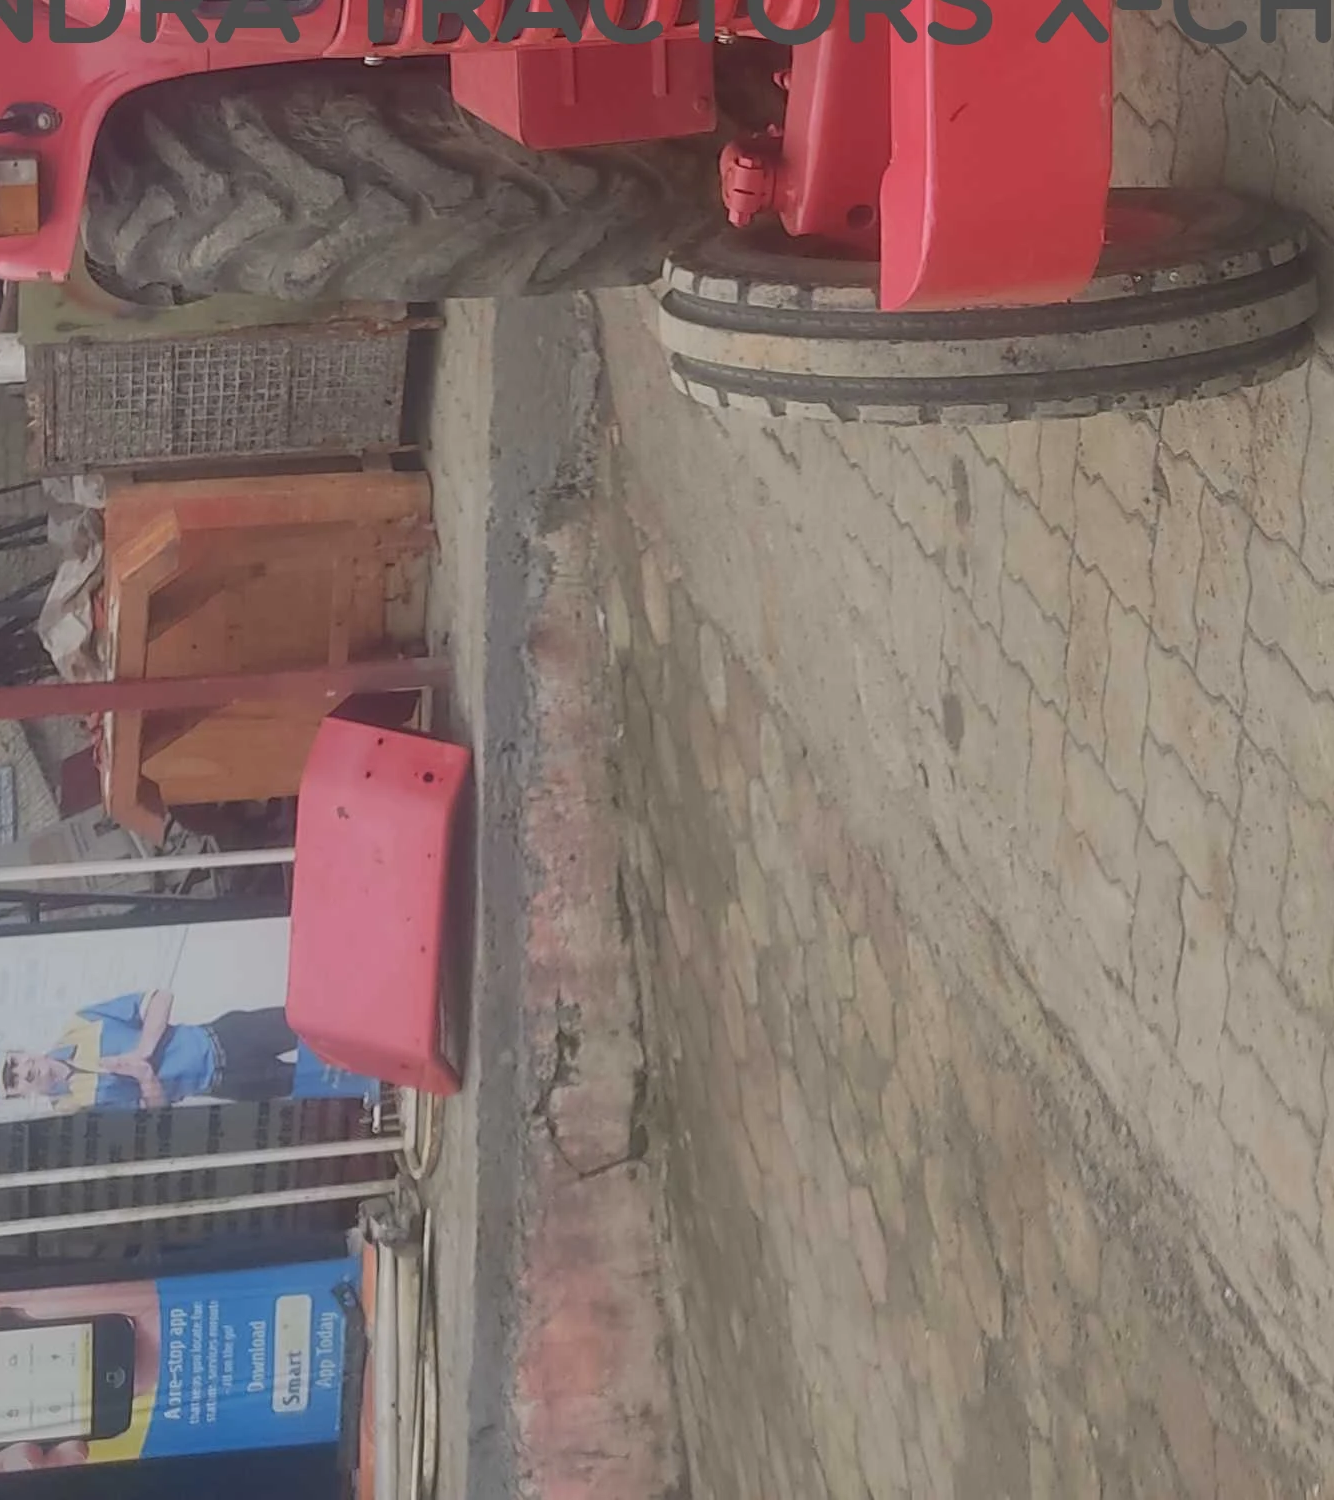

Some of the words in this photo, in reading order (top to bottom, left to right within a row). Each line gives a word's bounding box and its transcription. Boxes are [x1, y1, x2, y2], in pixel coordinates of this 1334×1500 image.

[170, 1308, 187, 1335] app
[317, 1312, 337, 1356] Today
[247, 1321, 267, 1393] Download
[282, 1350, 302, 1406] Smart
[315, 1359, 335, 1388] App
